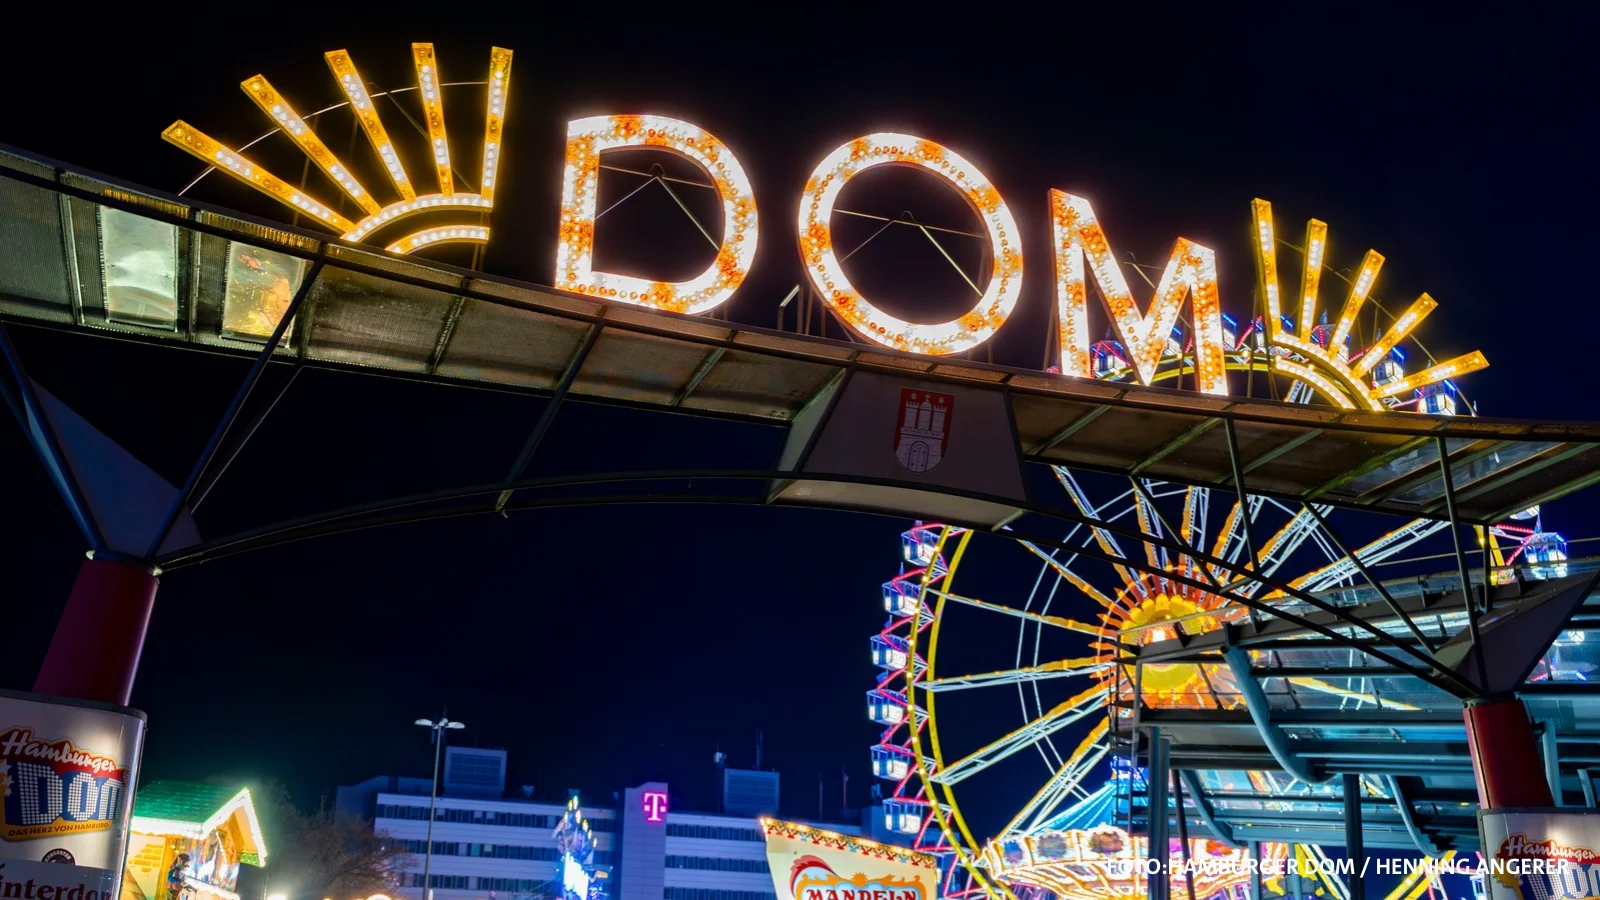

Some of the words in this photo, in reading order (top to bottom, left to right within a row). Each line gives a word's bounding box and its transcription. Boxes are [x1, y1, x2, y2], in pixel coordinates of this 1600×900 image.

[555, 114, 1228, 397] DOM
[2, 731, 116, 774] Hamburger
[8, 829, 28, 837] DAS
[30, 824, 52, 834] HERZ
[55, 823, 74, 832] VON
[74, 822, 109, 830] HAMBURG
[1505, 836, 1595, 862] Hamburger
